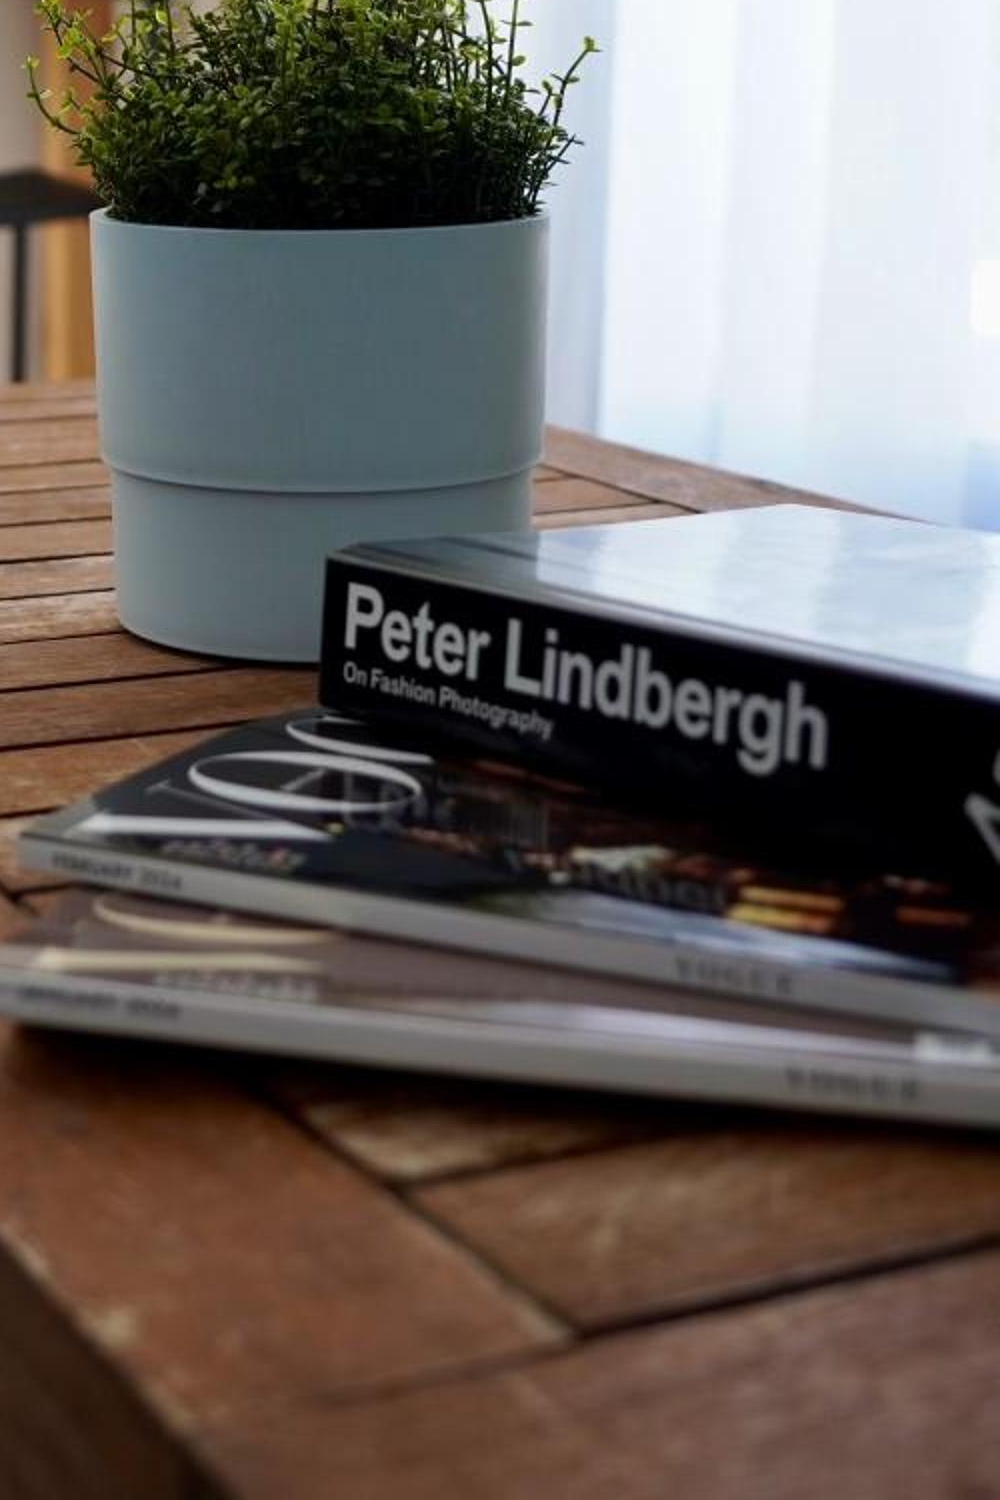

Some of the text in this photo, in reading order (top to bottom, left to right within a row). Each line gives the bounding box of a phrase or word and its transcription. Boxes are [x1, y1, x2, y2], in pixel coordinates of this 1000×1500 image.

[343, 661, 554, 741] On Fashion Photography
[345, 581, 828, 776] Peter Lindbergh
